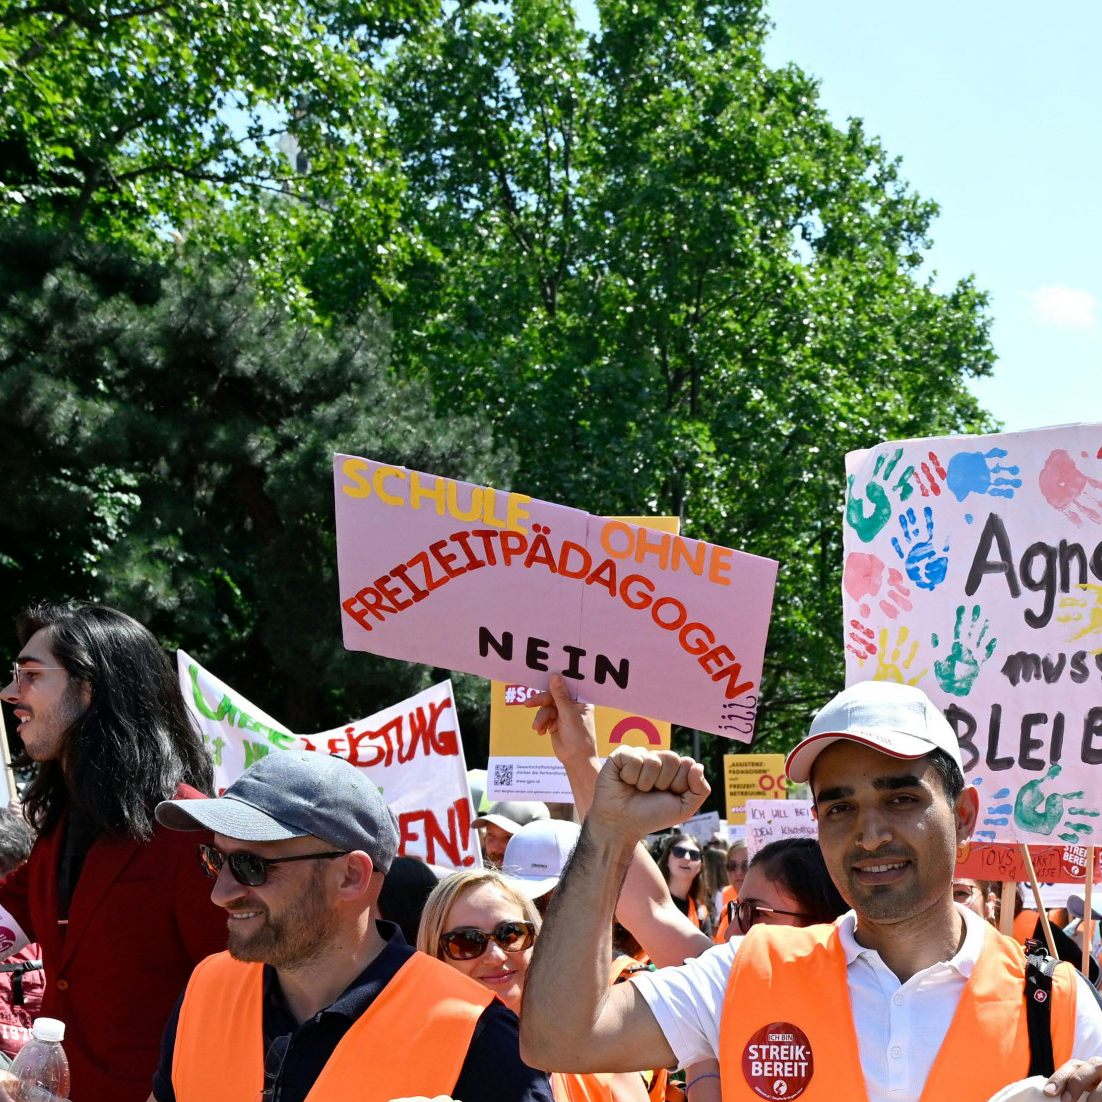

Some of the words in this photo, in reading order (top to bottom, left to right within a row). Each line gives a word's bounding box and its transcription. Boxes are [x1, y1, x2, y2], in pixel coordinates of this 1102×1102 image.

[342, 458, 531, 535] SCHULE
[601, 521, 733, 586] OHNE
[478, 626, 630, 689] NEIN
[300, 697, 459, 767] EISTUNG
[1063, 845, 1088, 857] STREI
[1063, 852, 1088, 867] BEREI
[748, 1044, 811, 1060] STREIK-
[751, 1061, 808, 1077] BEREIT
